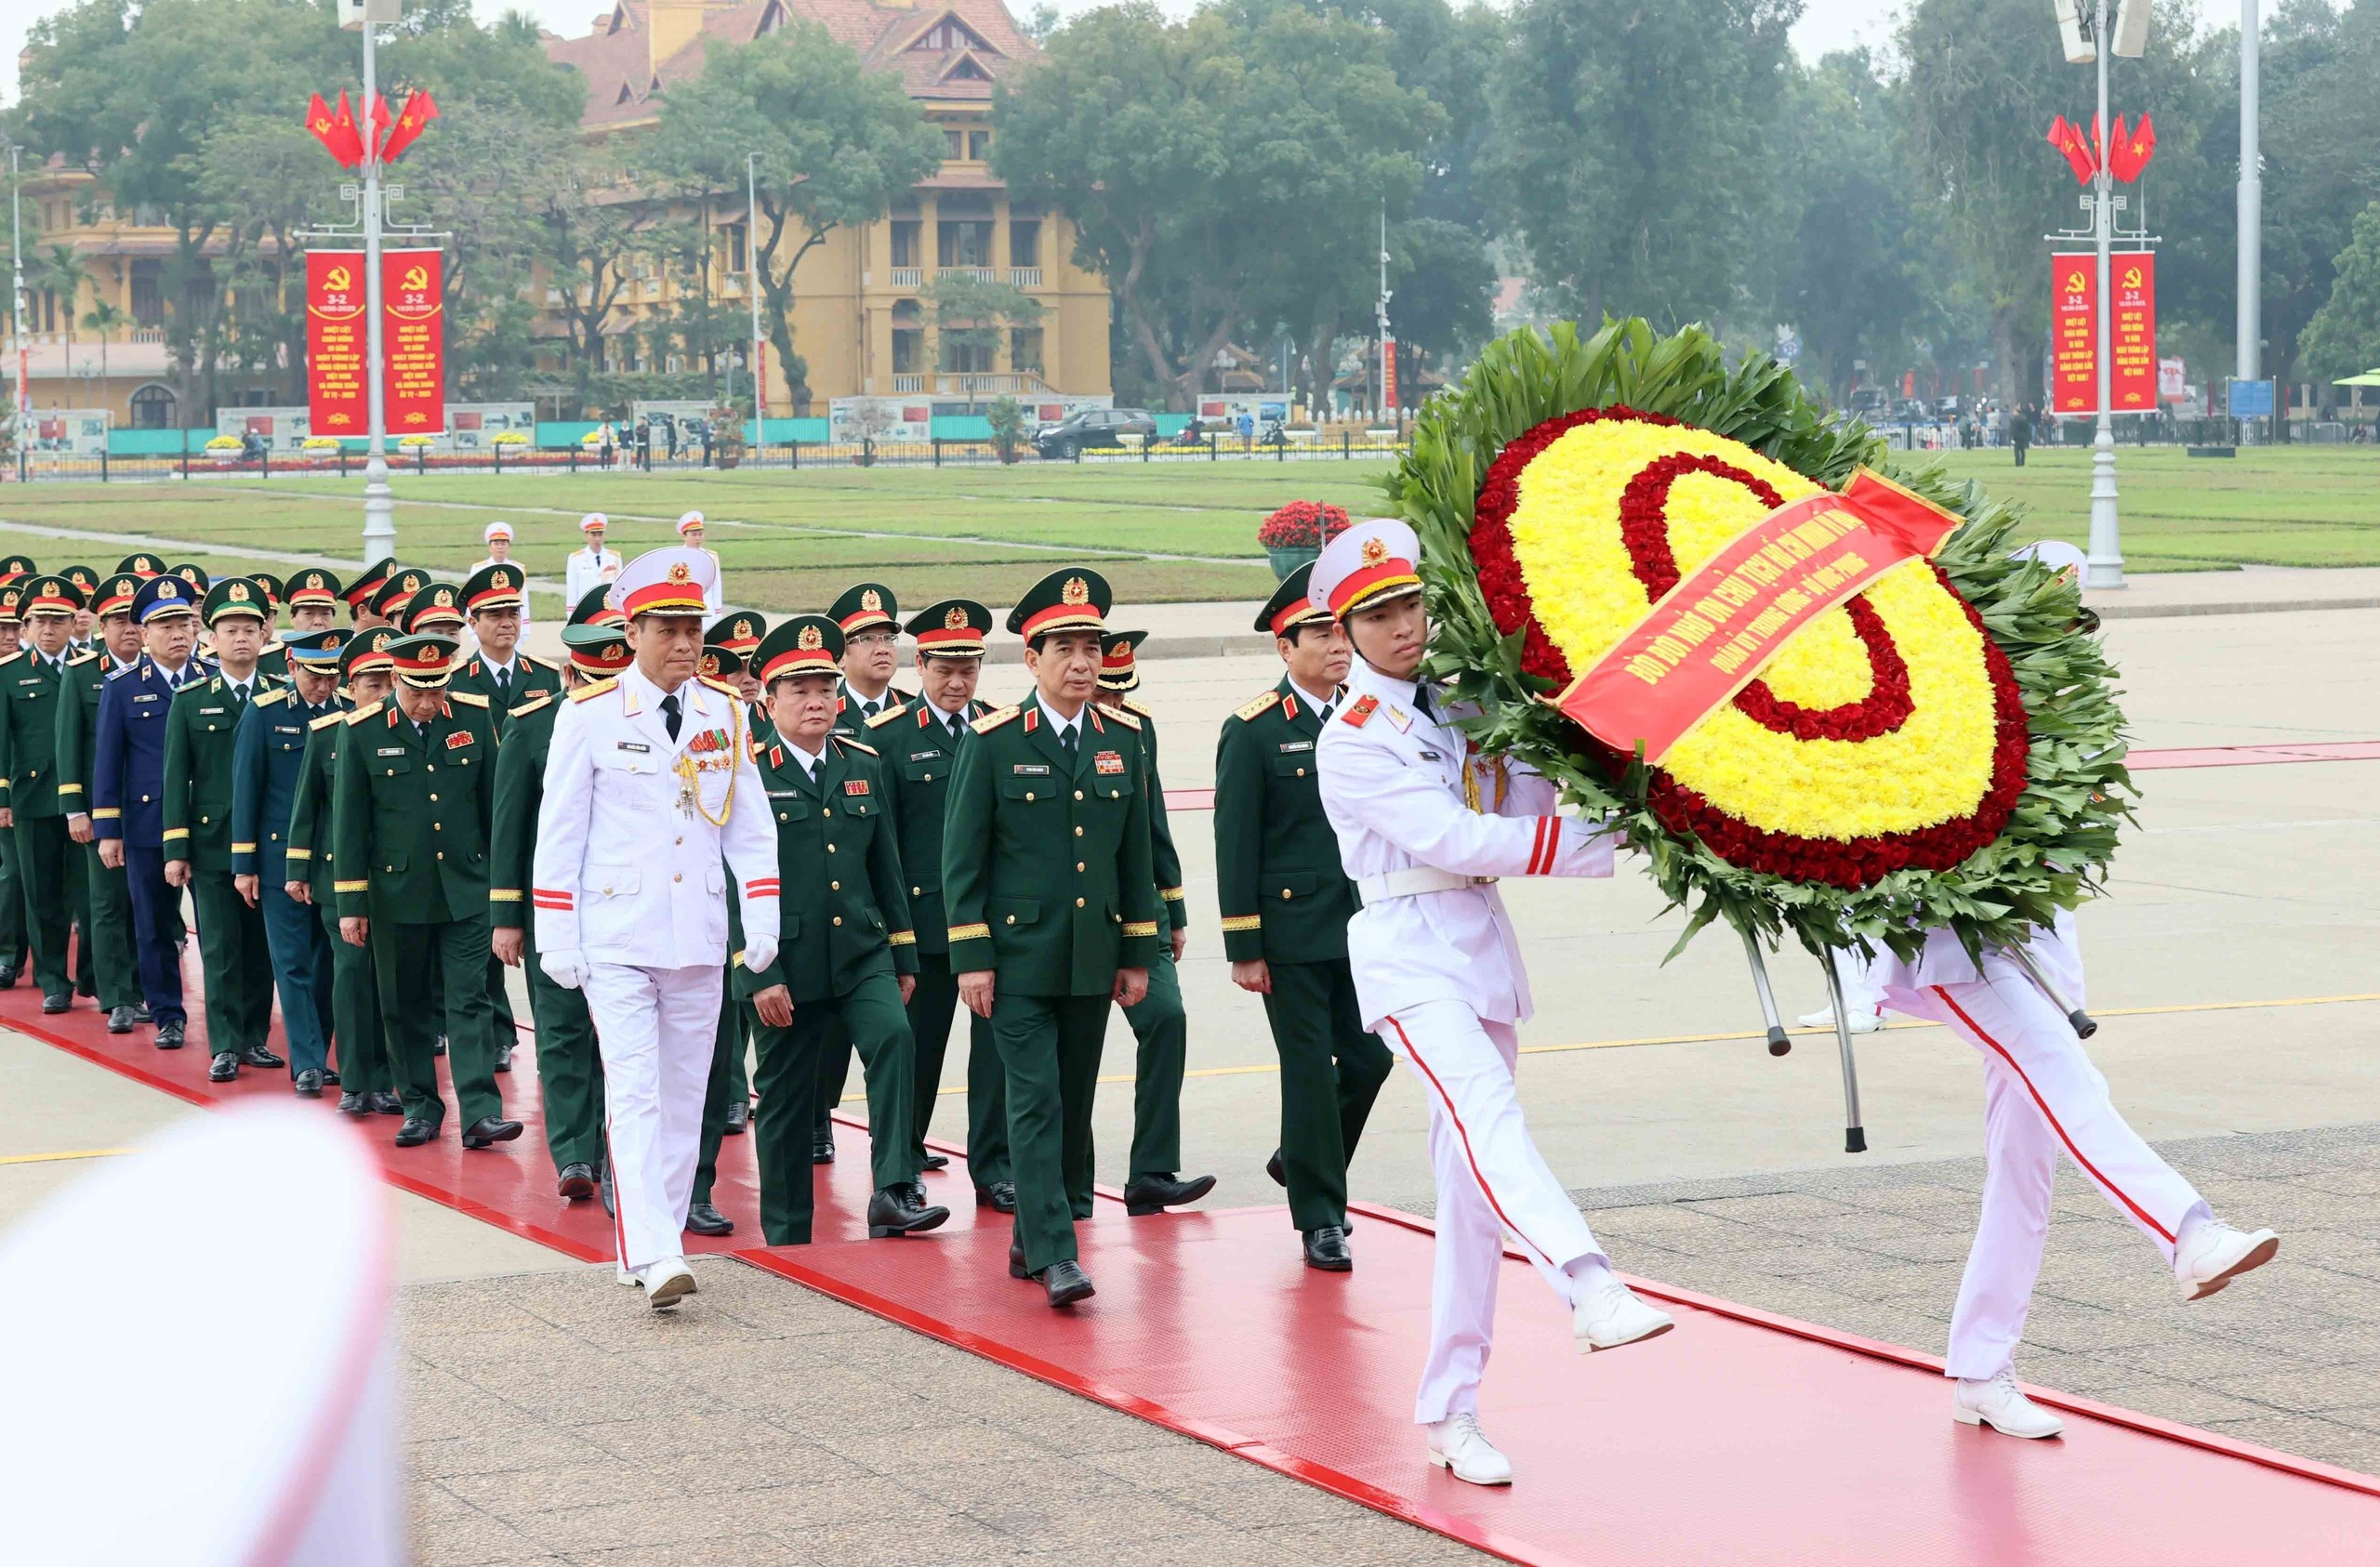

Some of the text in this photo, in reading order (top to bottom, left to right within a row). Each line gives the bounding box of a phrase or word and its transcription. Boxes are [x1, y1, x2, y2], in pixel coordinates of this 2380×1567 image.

[327, 294, 347, 304] 3-2
[405, 294, 424, 304] 3-2
[2068, 295, 2082, 304] 3-2
[2125, 291, 2139, 300] 3-2
[1791, 519, 1839, 552] MINH
[1813, 511, 1849, 537] VĨ
[1759, 534, 1798, 570] HỒ
[1776, 527, 1815, 560] CHÍ
[1734, 553, 1784, 587] TỊCH
[1812, 563, 1845, 590] QUỐC
[1829, 552, 1869, 579] PHÒNG
[1712, 569, 1758, 607] CHỦ
[1800, 573, 1831, 596] BỘ
[1694, 596, 1737, 623] ƠN
[1773, 587, 1813, 615] ƯƠNG
[1667, 610, 1716, 647] NHỚ
[1745, 606, 1792, 639] TRUNG
[1645, 635, 1692, 667] ĐỜI
[1710, 642, 1751, 675] QUÂN
[1623, 654, 1671, 685] ĐỜI
